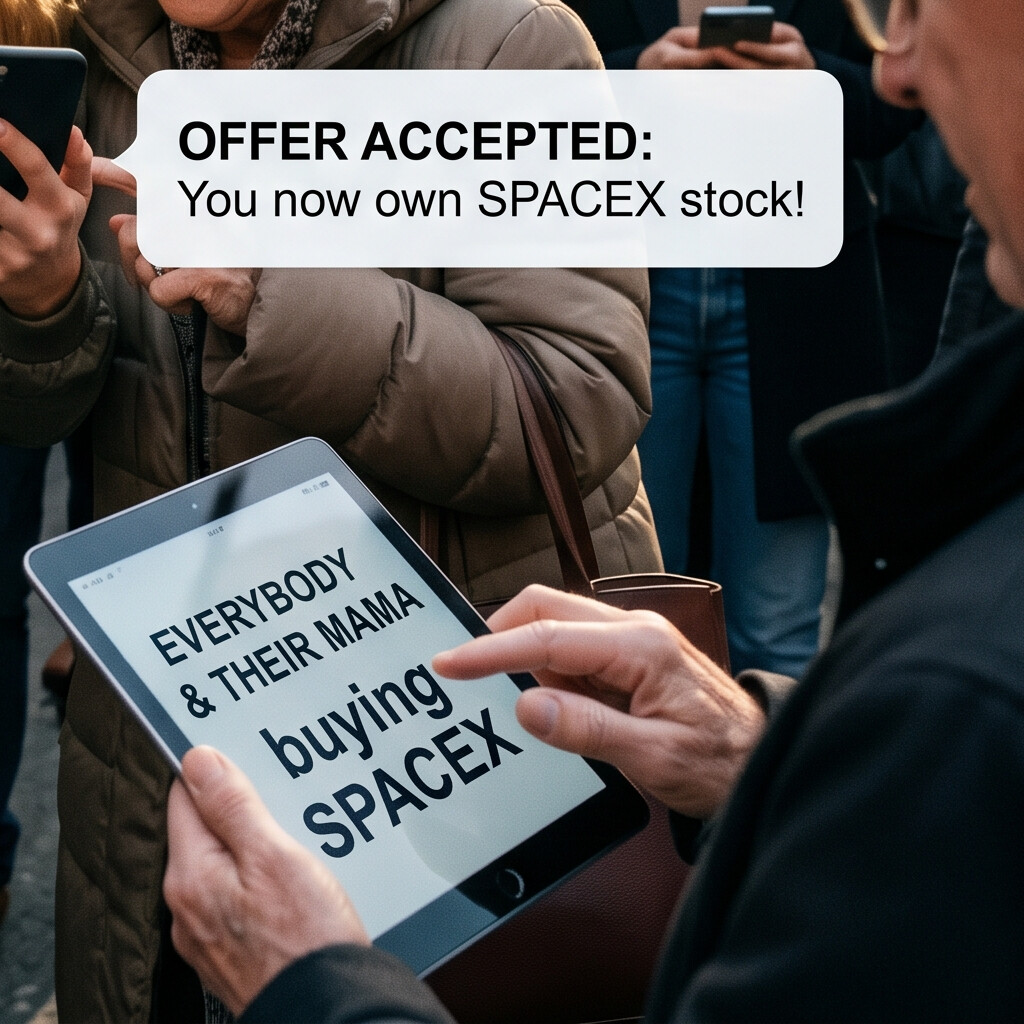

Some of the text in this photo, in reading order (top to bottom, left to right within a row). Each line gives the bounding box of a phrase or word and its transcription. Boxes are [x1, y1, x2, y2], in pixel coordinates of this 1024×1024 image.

[148, 547, 357, 667] EVERYBODY
[179, 581, 426, 719] & THEIR MAMA
[258, 662, 455, 780] buying
[302, 706, 525, 859] SPACEX
